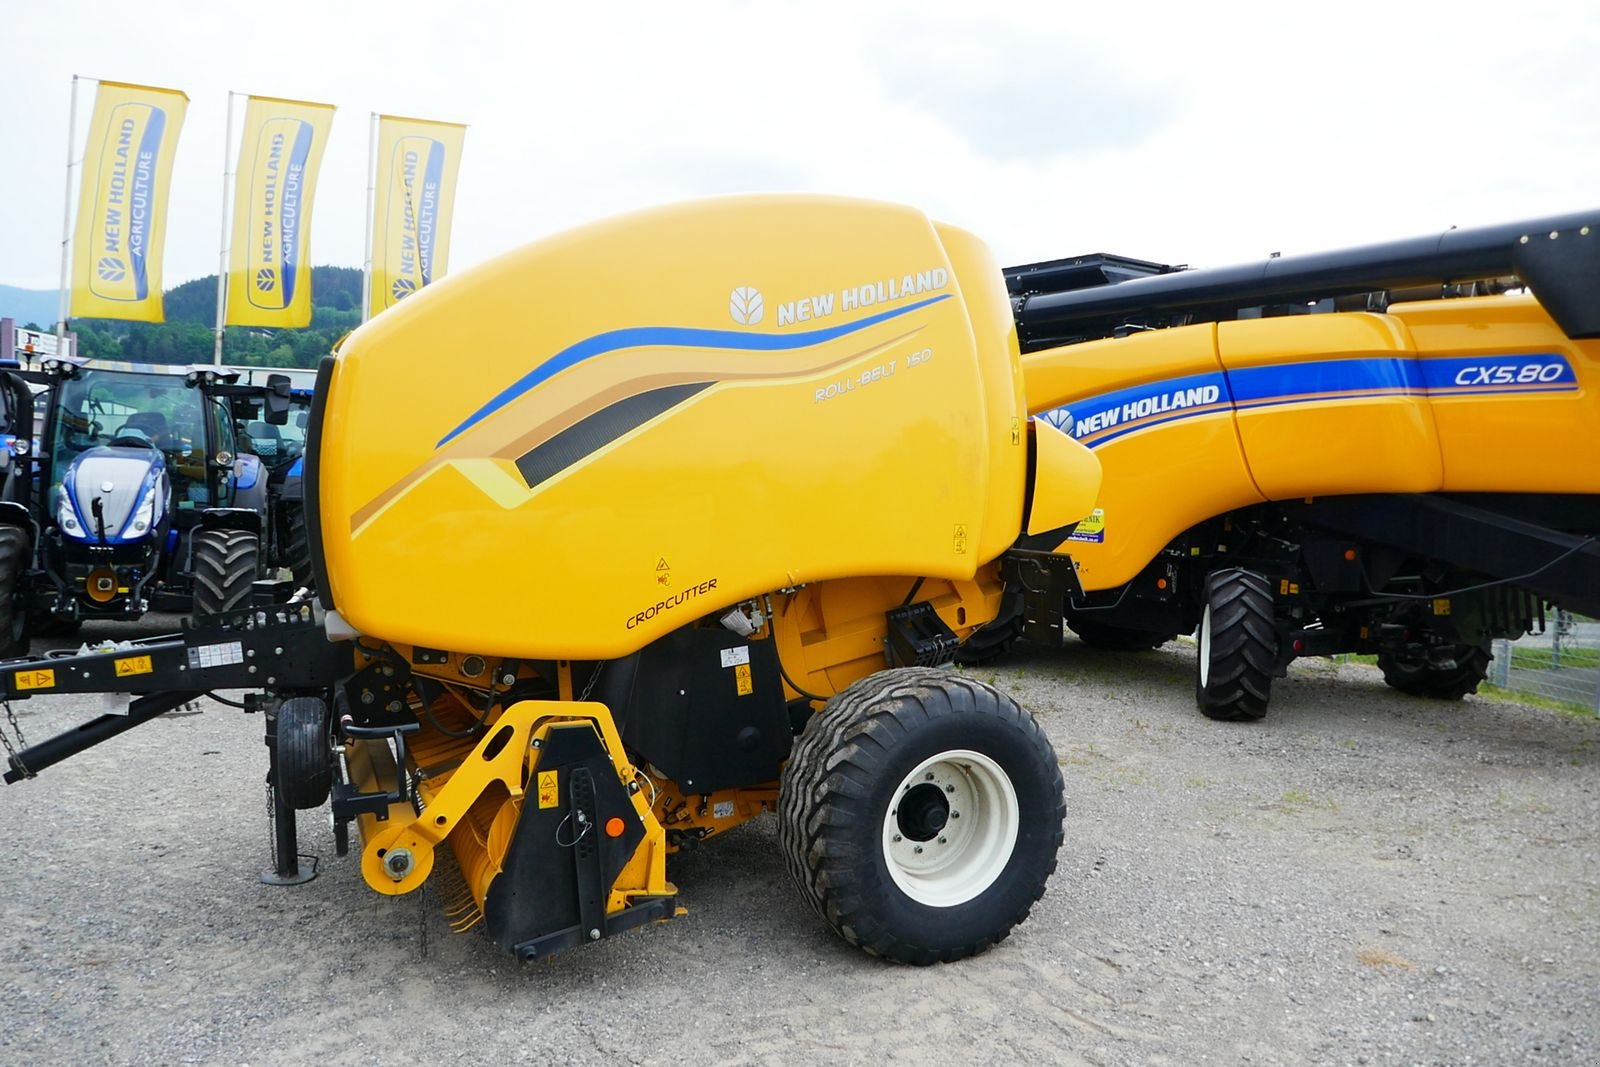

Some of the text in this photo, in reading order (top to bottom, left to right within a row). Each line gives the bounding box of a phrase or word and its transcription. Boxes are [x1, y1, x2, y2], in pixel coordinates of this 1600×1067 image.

[105, 118, 135, 252] NEW HOLLAND
[130, 151, 153, 257] AGRICULTURE
[263, 133, 285, 262] NEW HOLLAND
[283, 163, 302, 265] AGRICULTURE
[400, 234, 416, 274] NEW
[421, 182, 437, 279] AGRICULTURE
[777, 267, 948, 327] NEW HOLLAND
[814, 348, 933, 404] ROLL-BELT 150
[1455, 363, 1564, 385] CX5.80
[1076, 385, 1220, 438] NEW HOLLAND
[626, 578, 718, 630] CROPCUTTER
